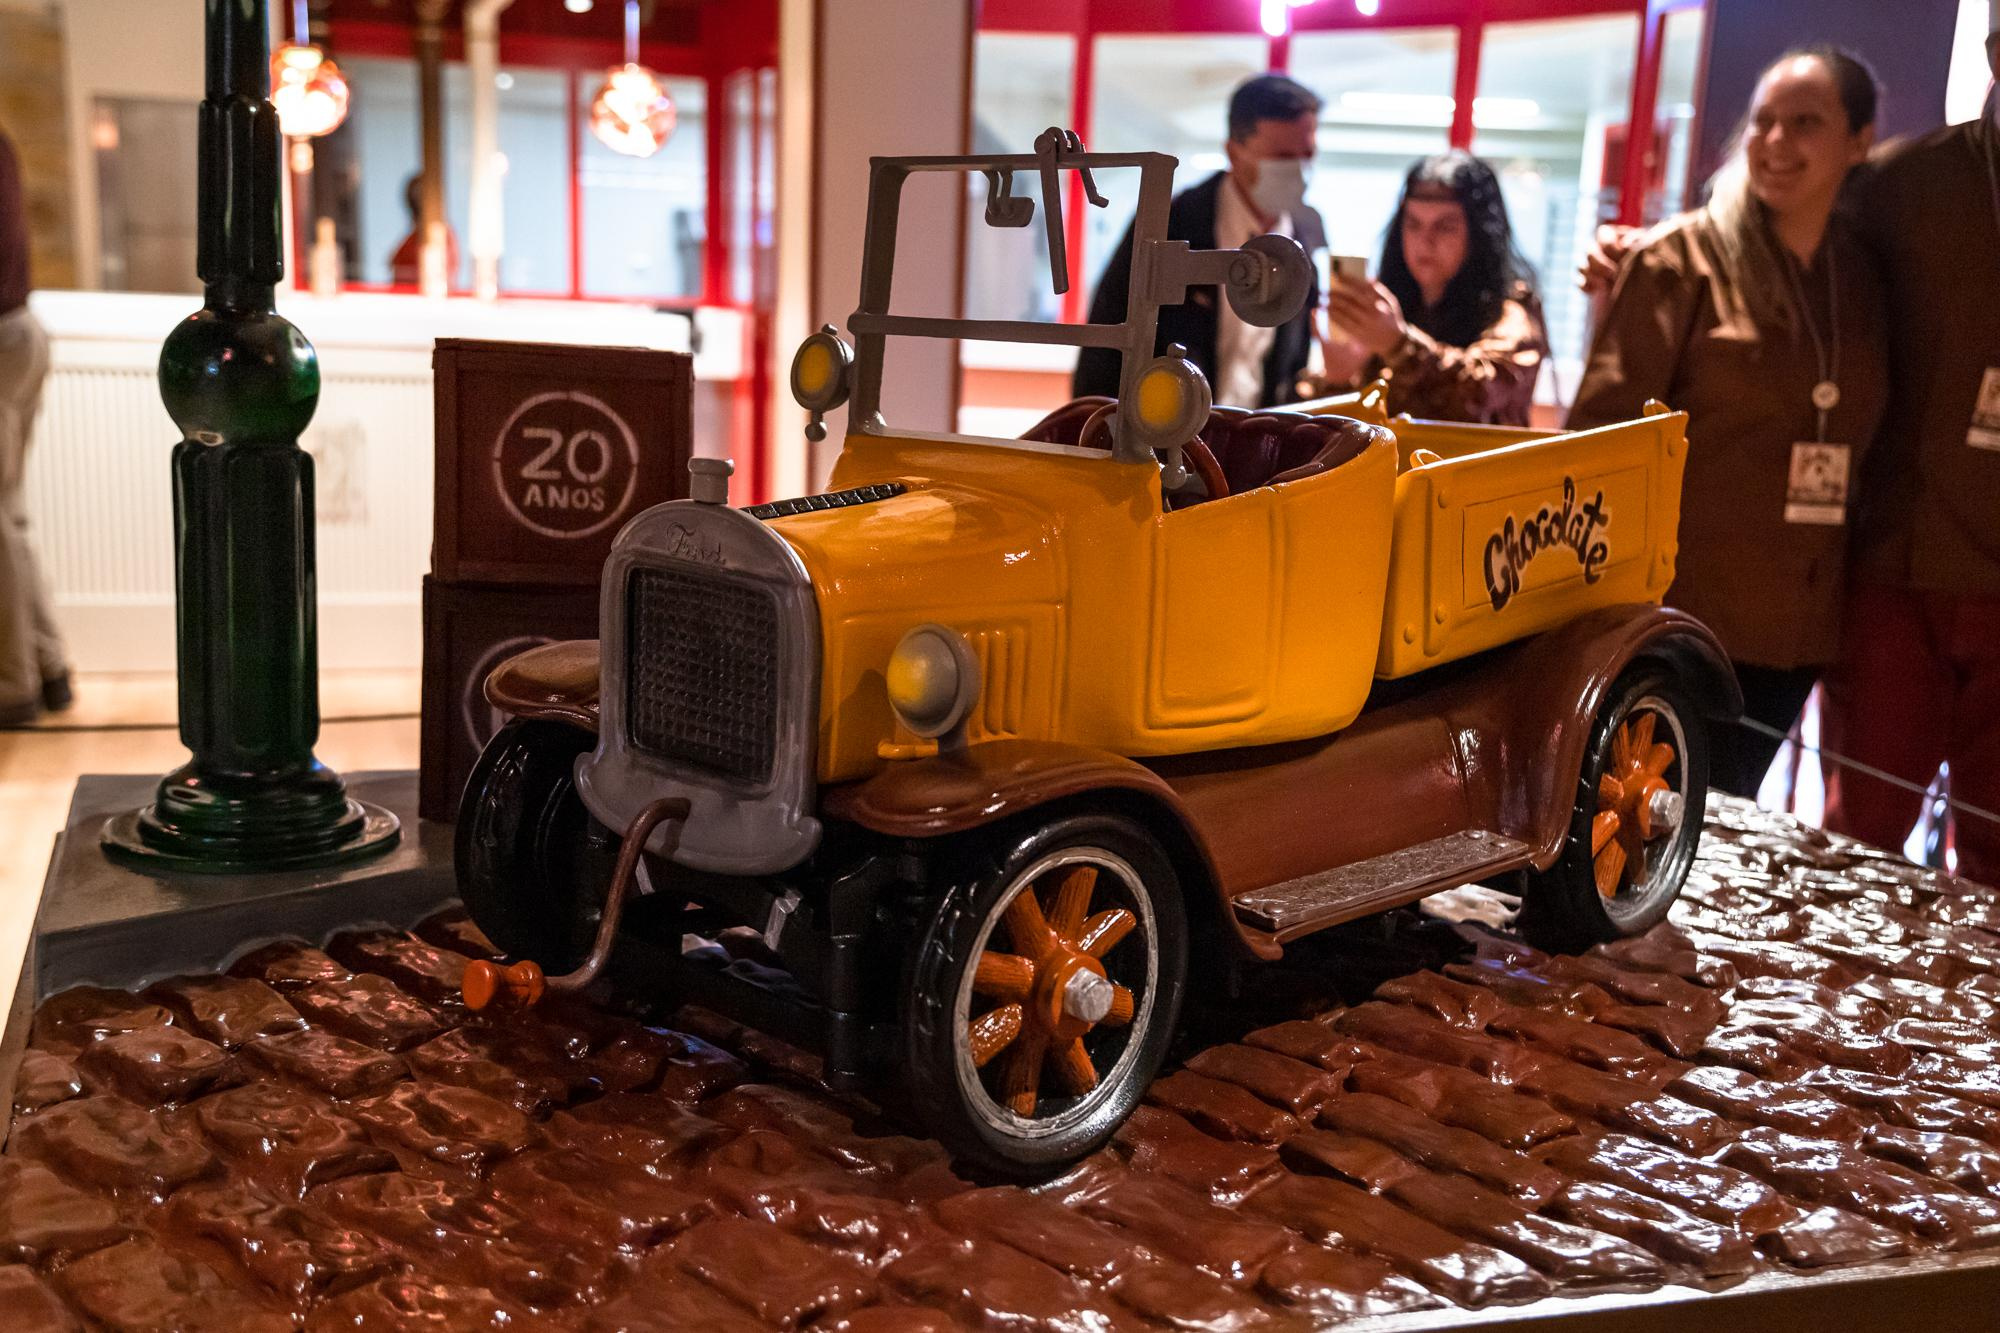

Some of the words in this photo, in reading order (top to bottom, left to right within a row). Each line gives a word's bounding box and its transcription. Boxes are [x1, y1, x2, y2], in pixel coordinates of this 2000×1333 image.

[521, 427, 611, 482] 20
[524, 484, 605, 511] ANOS
[1483, 475, 1609, 612] Chocolate
